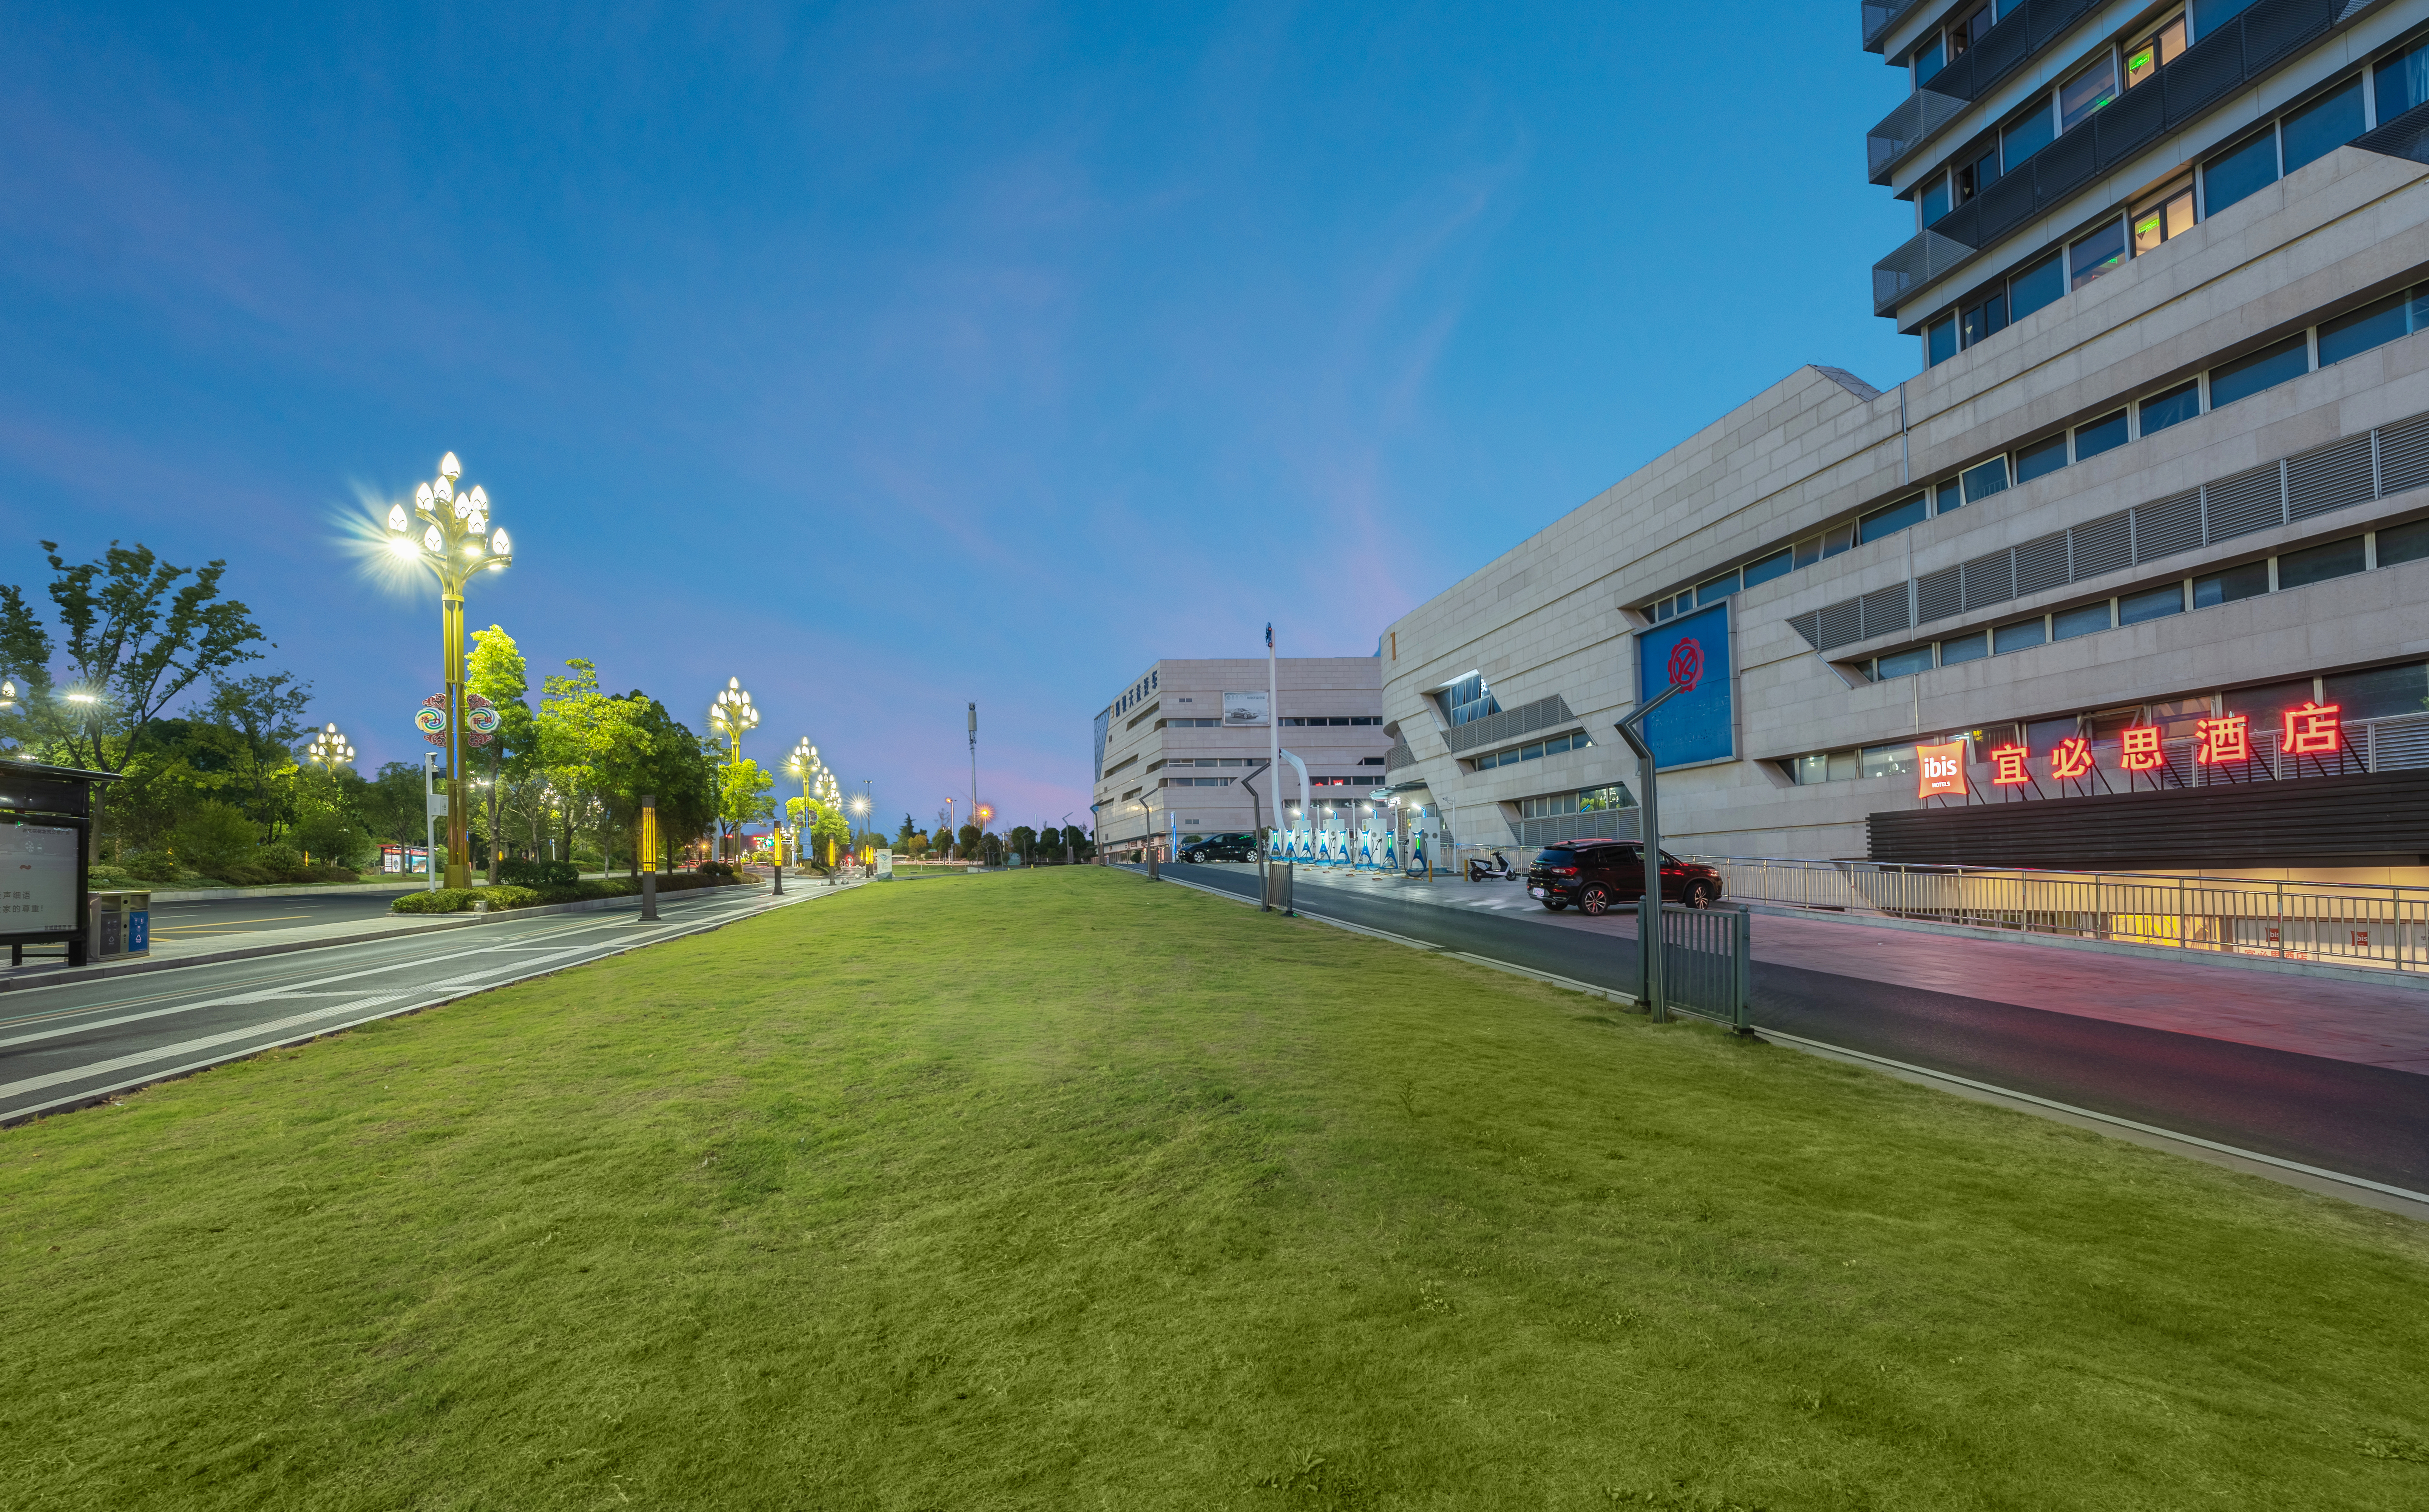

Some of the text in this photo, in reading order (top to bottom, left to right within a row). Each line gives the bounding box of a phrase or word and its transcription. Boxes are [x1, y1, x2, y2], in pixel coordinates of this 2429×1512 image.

[1991, 702, 2340, 785] 宜必思酒店
[1924, 755, 1957, 778] ibis
[0, 905, 43, 913] 家的尊重!
